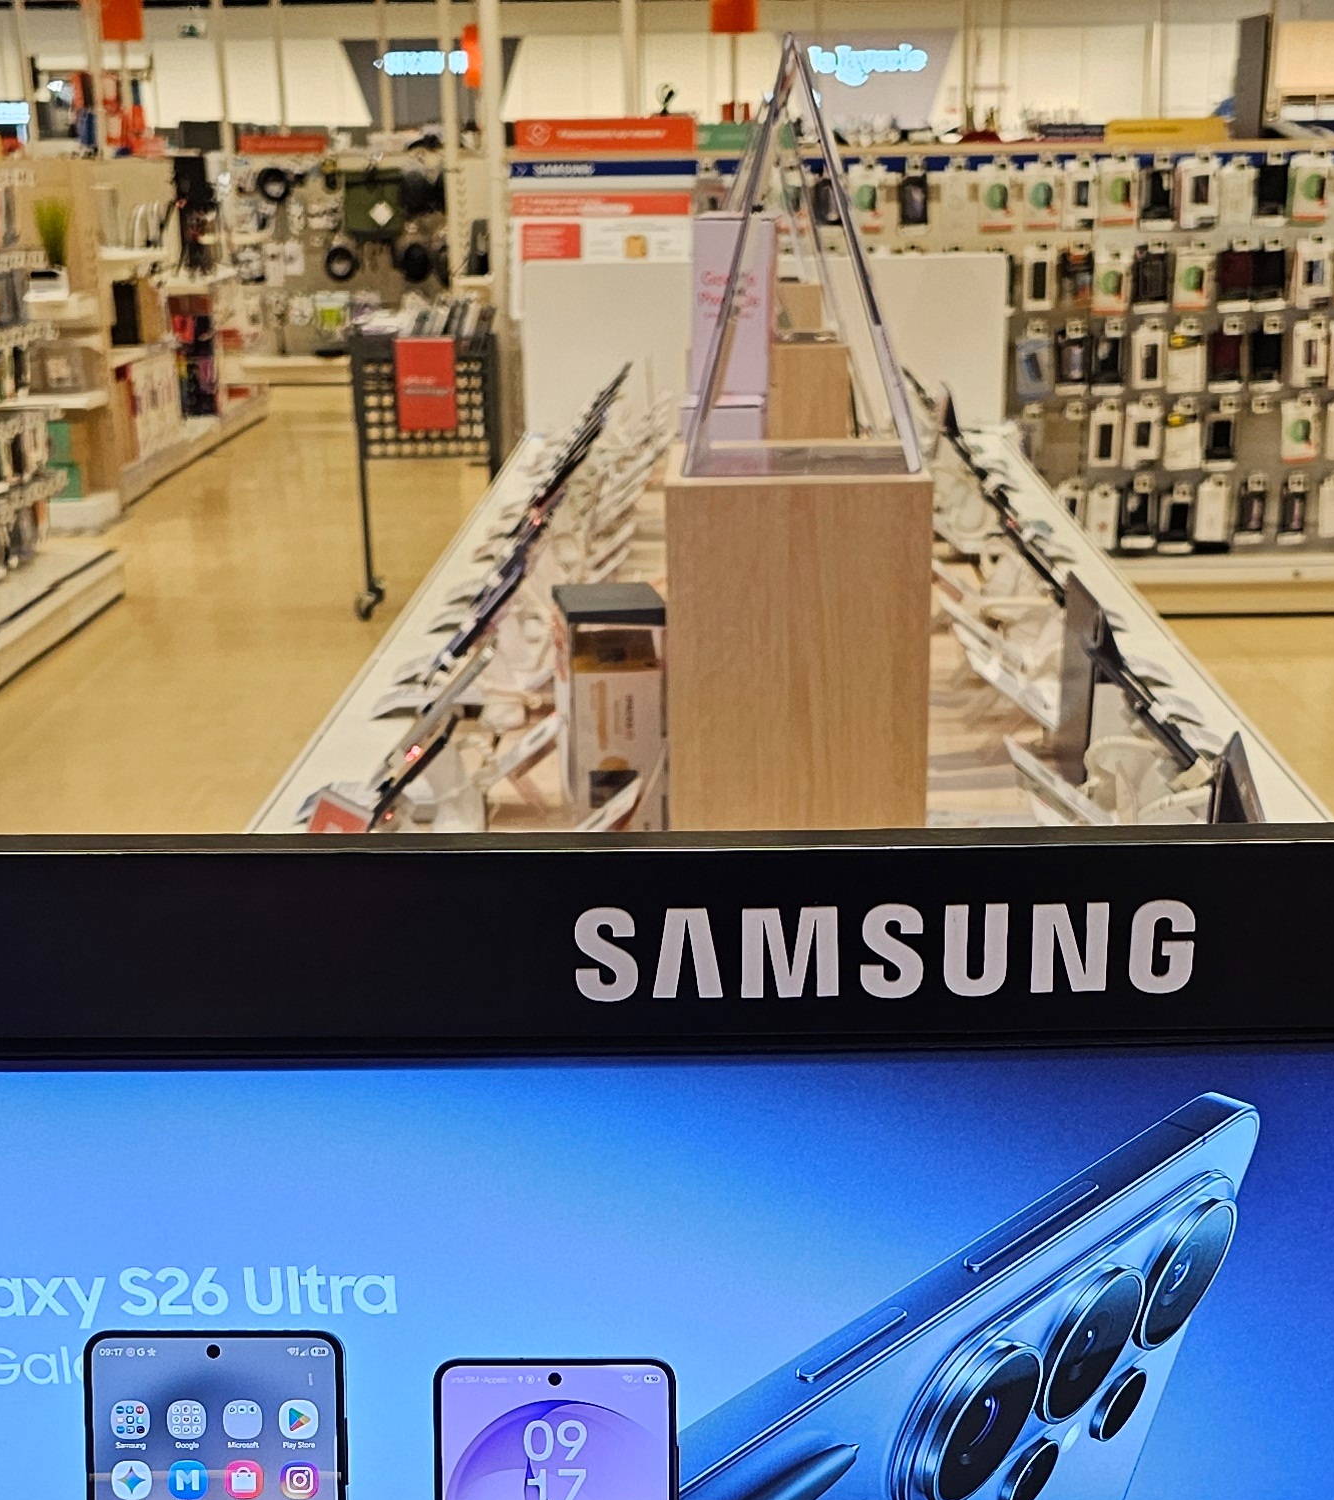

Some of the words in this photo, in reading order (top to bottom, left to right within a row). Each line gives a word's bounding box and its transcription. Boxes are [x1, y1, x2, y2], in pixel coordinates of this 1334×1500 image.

[574, 900, 1197, 1003] SAMSUNG
[118, 1268, 228, 1317] S26
[244, 1265, 397, 1317] Ultra
[99, 1348, 123, 1356] 09:17
[175, 1441, 199, 1450] Google
[283, 1441, 295, 1450] Play
[523, 1420, 588, 1462] 09
